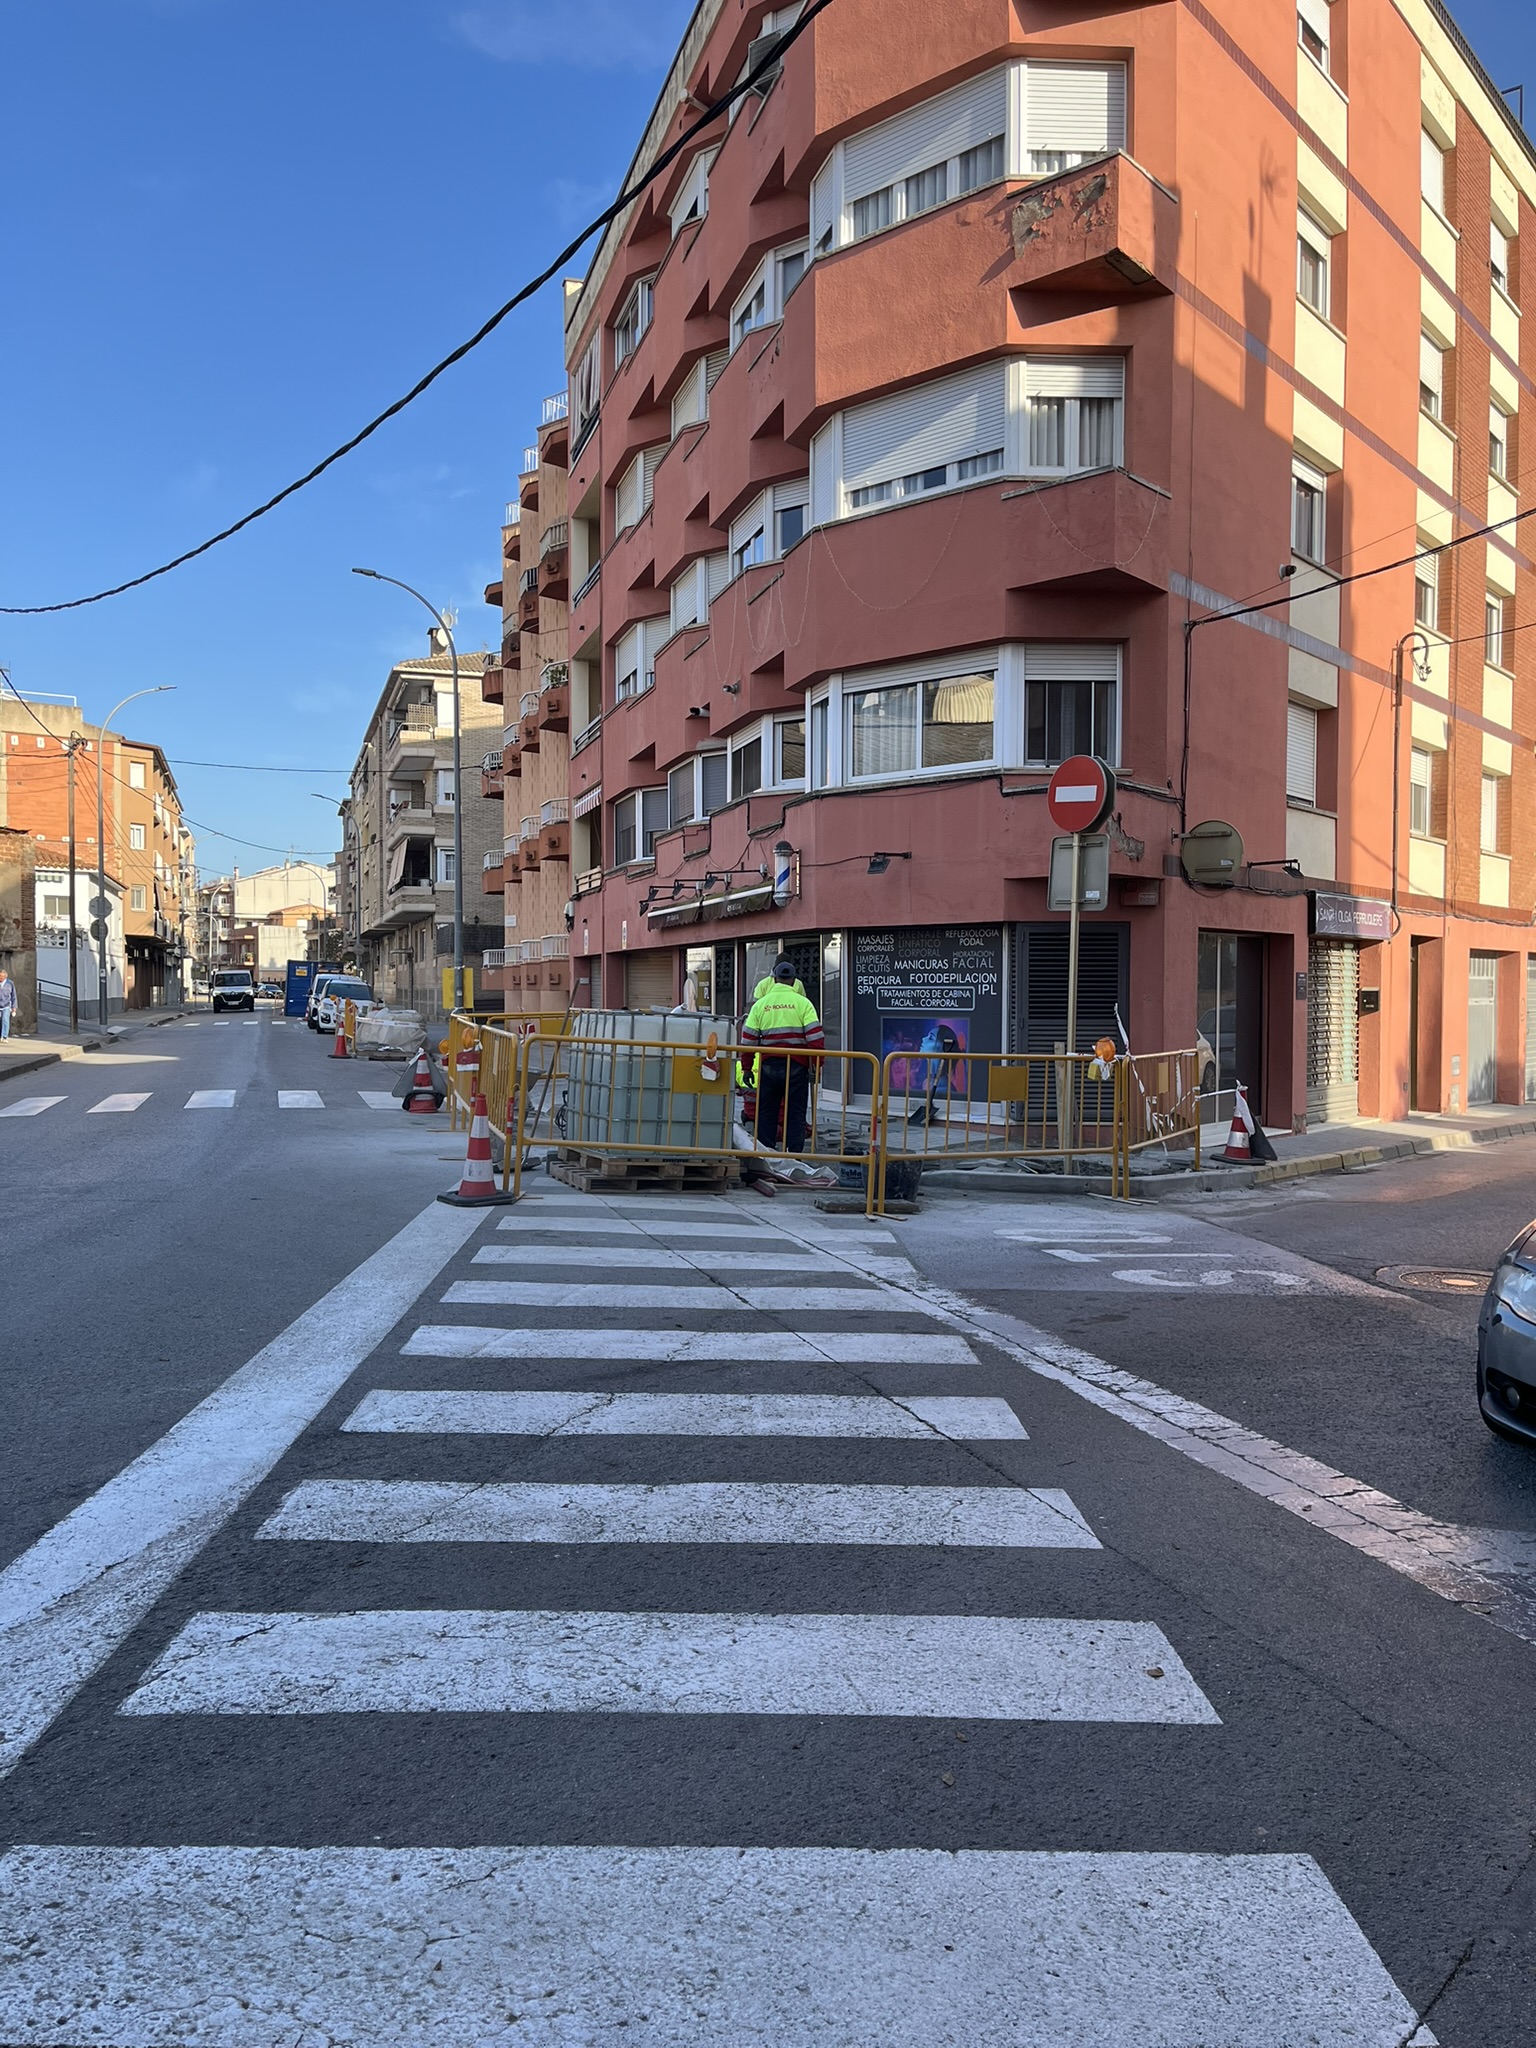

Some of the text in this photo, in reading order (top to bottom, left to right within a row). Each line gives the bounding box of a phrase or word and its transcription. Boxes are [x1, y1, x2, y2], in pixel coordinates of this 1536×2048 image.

[899, 930, 941, 939] DRENAJE
[945, 929, 999, 939] REFLEXOLOGIA
[857, 934, 895, 945] MASAJES
[899, 939, 941, 948] LINFATICO
[959, 937, 984, 946] PODAL
[899, 948, 941, 958] CORPORAL
[856, 955, 890, 964] LIMPIEZA
[894, 959, 949, 970] MANICURAS
[952, 957, 994, 969] FACIAL
[856, 963, 891, 973] DE CUTIS
[857, 975, 902, 985] PEDICURA
[909, 973, 997, 984] FOTODEPILACION
[857, 985, 874, 995] SPA
[880, 989, 971, 998] TRATAMIENTOS DE CABINA
[978, 984, 997, 995] IPL
[891, 998, 914, 1007] FACIAL
[920, 998, 959, 1007] CORPORAL
